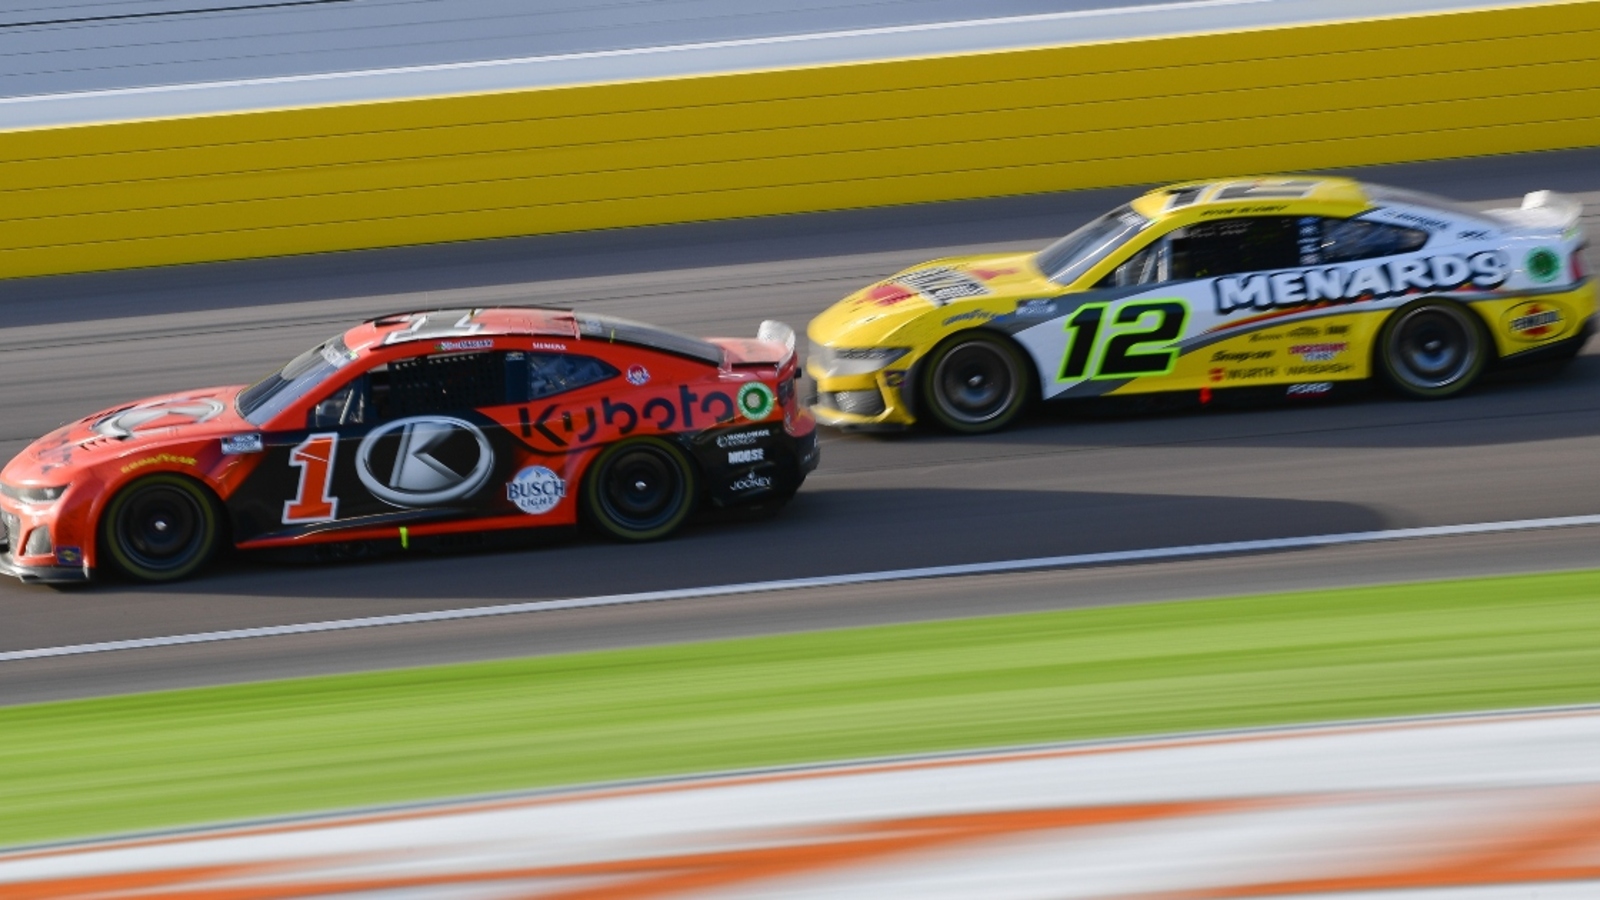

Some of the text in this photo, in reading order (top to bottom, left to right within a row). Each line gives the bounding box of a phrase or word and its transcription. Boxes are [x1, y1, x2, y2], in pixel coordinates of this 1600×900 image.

[1212, 250, 1511, 315] MENARDS
[532, 341, 567, 351] SIEMENS
[1057, 297, 1191, 383] 12
[518, 384, 735, 447] Kubota
[728, 448, 764, 464] MOOSE
[282, 432, 338, 525] 1
[729, 477, 772, 491] JOCKEY
[507, 480, 566, 500] BUSCH
[520, 497, 554, 507] LIGHT
